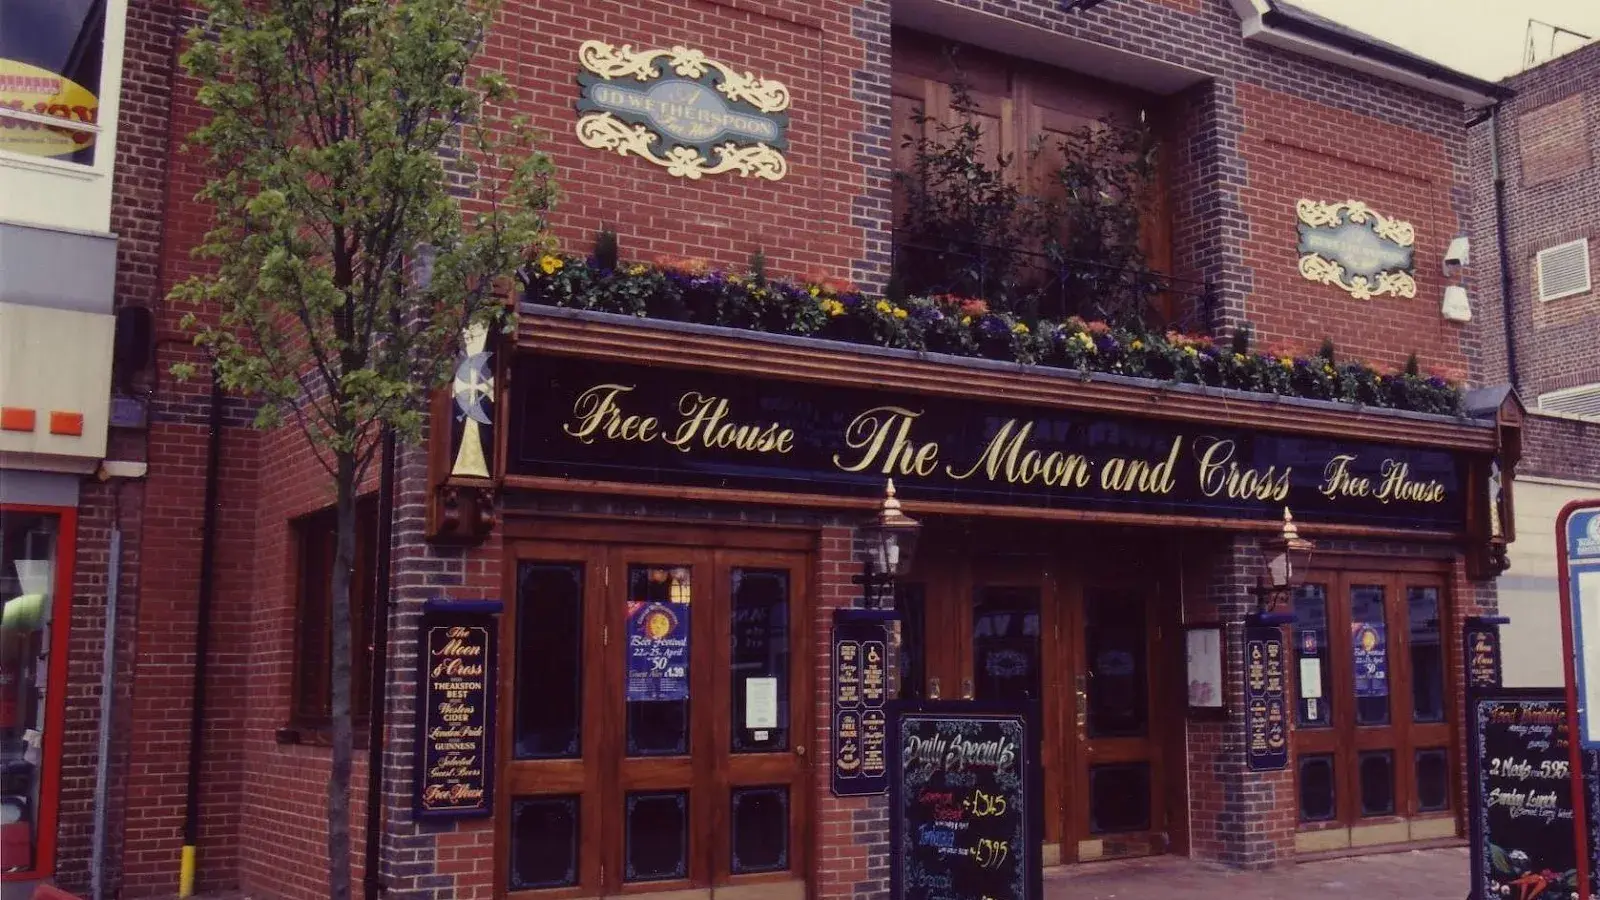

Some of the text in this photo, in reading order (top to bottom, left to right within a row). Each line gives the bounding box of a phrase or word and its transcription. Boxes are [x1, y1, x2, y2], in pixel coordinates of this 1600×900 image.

[563, 383, 795, 453] Free House
[833, 405, 1292, 502] The Moon and Cross
[1318, 453, 1446, 504] Free House
[446, 626, 471, 638] The
[432, 639, 481, 656] Moon
[443, 658, 482, 675] Cross
[651, 657, 668, 670] 50
[434, 682, 482, 690] THEAKSTON
[446, 690, 469, 698] BEST
[443, 714, 469, 722] CIDER
[434, 742, 476, 750] GUINNESS
[904, 733, 947, 768] Daily
[946, 734, 1015, 773] Specials
[1489, 758, 1501, 775] 2
[1488, 788, 1558, 808] Sunday Lunch
